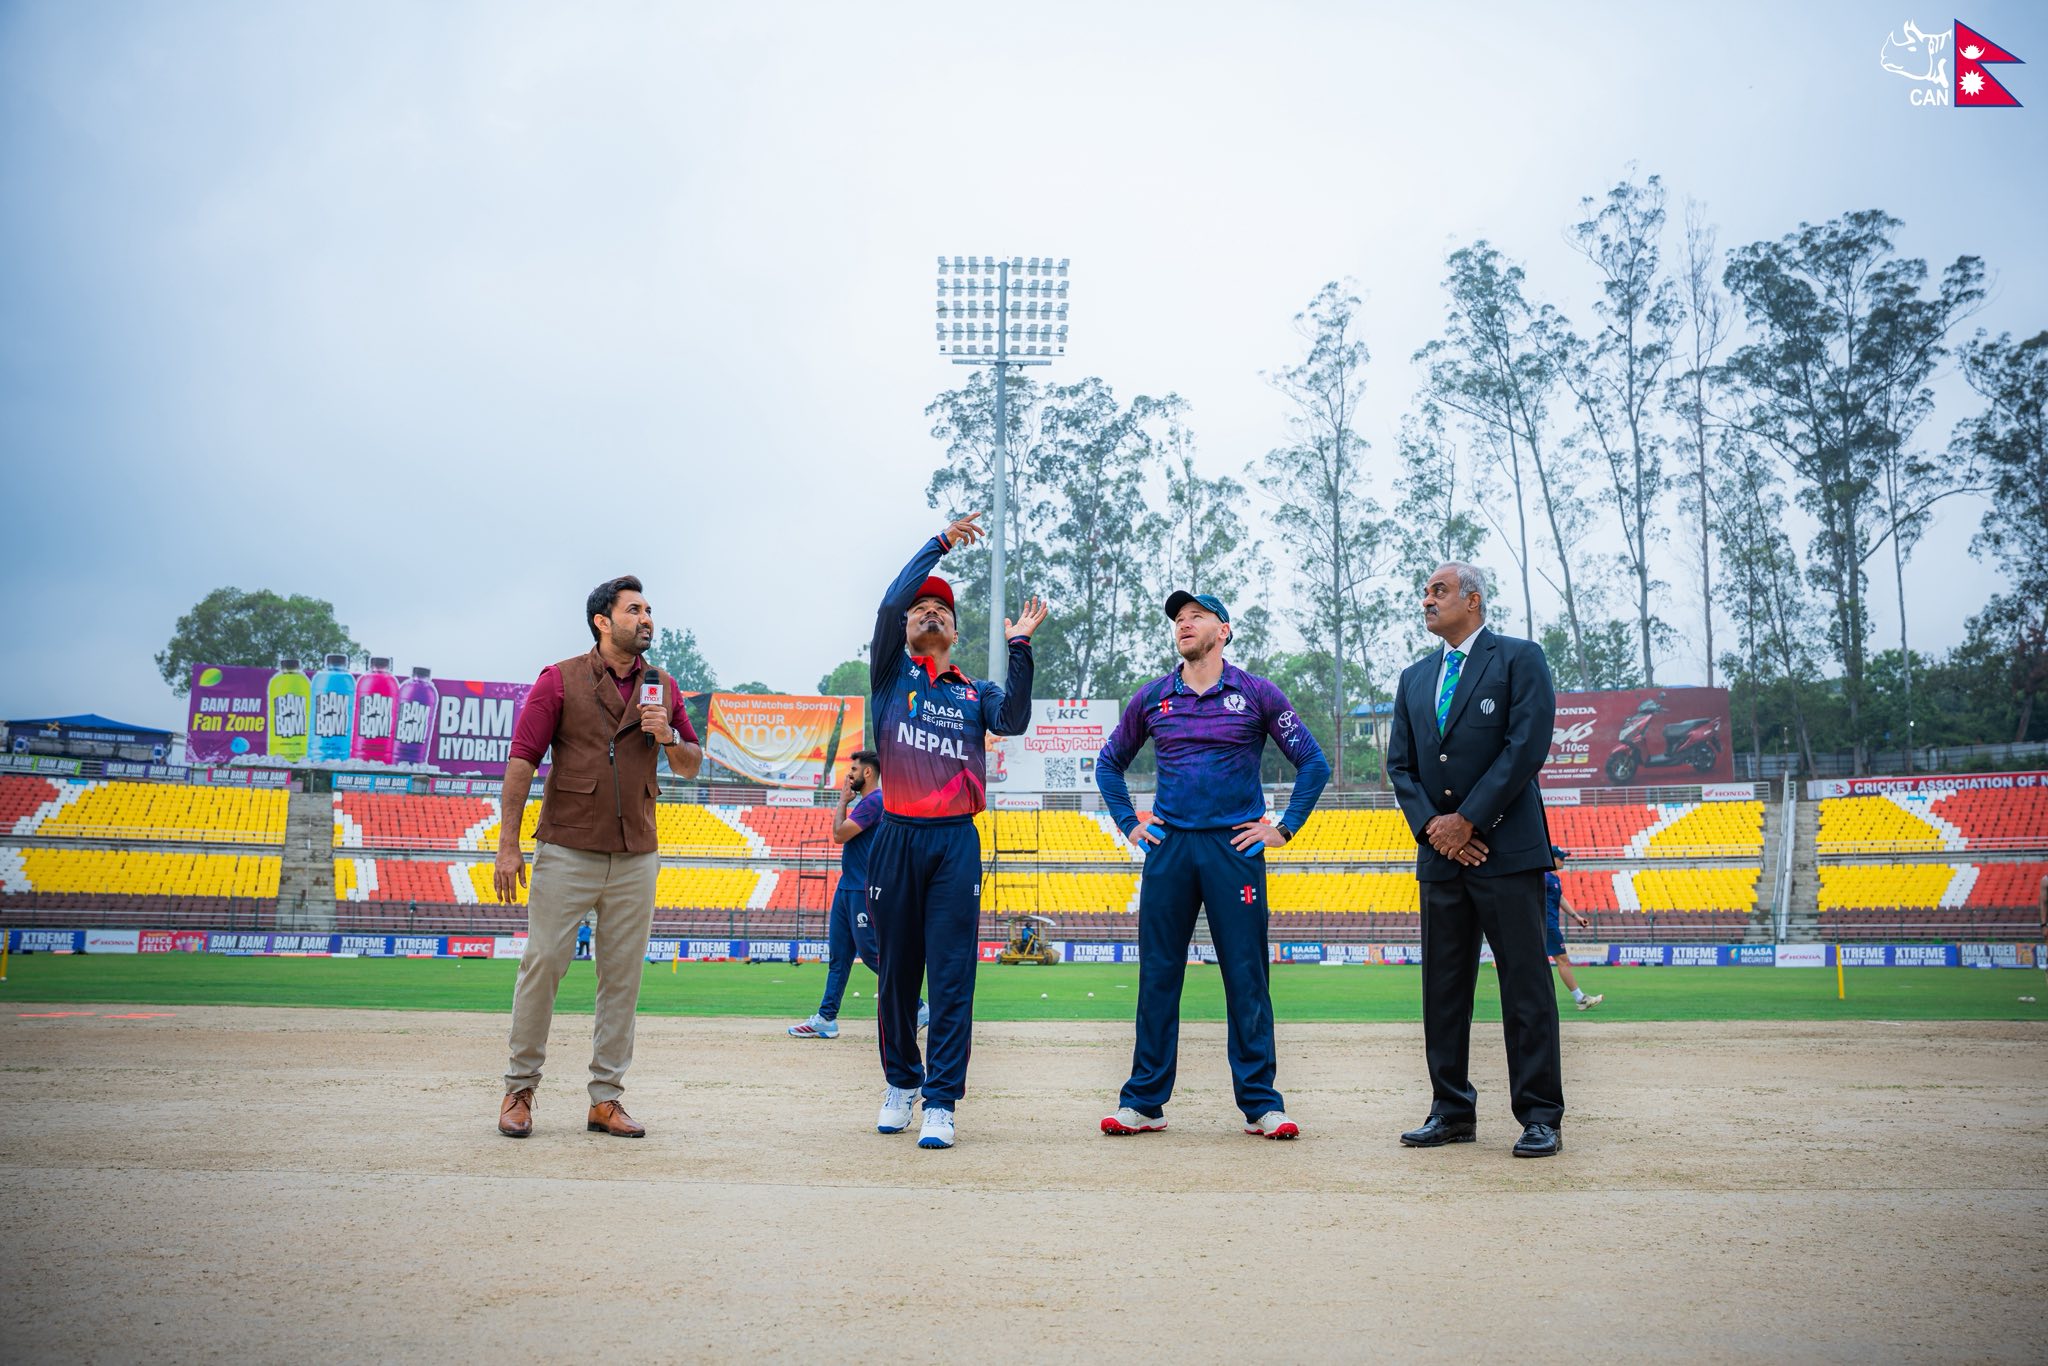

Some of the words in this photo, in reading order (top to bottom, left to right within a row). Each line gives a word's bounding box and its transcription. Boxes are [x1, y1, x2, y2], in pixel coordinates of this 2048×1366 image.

[200, 697, 230, 713] BAM
[232, 698, 262, 713] BAM
[720, 699, 749, 709] Nepal
[751, 700, 794, 710] Watches
[796, 701, 829, 712] Sports
[923, 699, 964, 719] NAASA
[439, 696, 515, 738] BAM
[725, 712, 785, 725] ANTIPUR
[1057, 708, 1089, 720] KFC
[192, 713, 223, 731] Fan
[225, 714, 266, 732] Zone
[897, 721, 968, 761] NEPAL
[1025, 737, 1072, 753] Loyalty
[1560, 743, 1590, 753] 110cc
[213, 769, 230, 779] BAM
[252, 771, 270, 780] BAM
[1854, 780, 1914, 794] CRICKET
[1917, 776, 2013, 791] ASSOCIATION
[2016, 775, 2037, 787] OF
[869, 885, 882, 900] 17
[22, 932, 75, 944] XTREME
[142, 936, 173, 944] JUICE
[211, 935, 236, 948] BAM
[238, 936, 268, 948] BAM!
[274, 936, 300, 949] BAM
[301, 937, 330, 949] BAM!
[341, 936, 387, 948] XTREME
[394, 938, 439, 950] XTREME
[141, 944, 172, 952] JELLY
[463, 943, 491, 953] KFC
[688, 942, 731, 953] XTREME
[749, 942, 791, 953] XTREME
[1073, 945, 1115, 955] XTREME
[1327, 945, 1346, 955] MAX
[1348, 945, 1369, 956] TIGER
[1384, 946, 1403, 956] MAX
[1620, 947, 1664, 958] XTREME
[1672, 947, 1718, 958] XTREME
[1741, 947, 1773, 956] NAASA
[1895, 947, 1946, 959] XTREME
[1961, 944, 1986, 956] MAX
[1988, 944, 2017, 956] TIGER
[1741, 956, 1773, 964] SECURITIES
